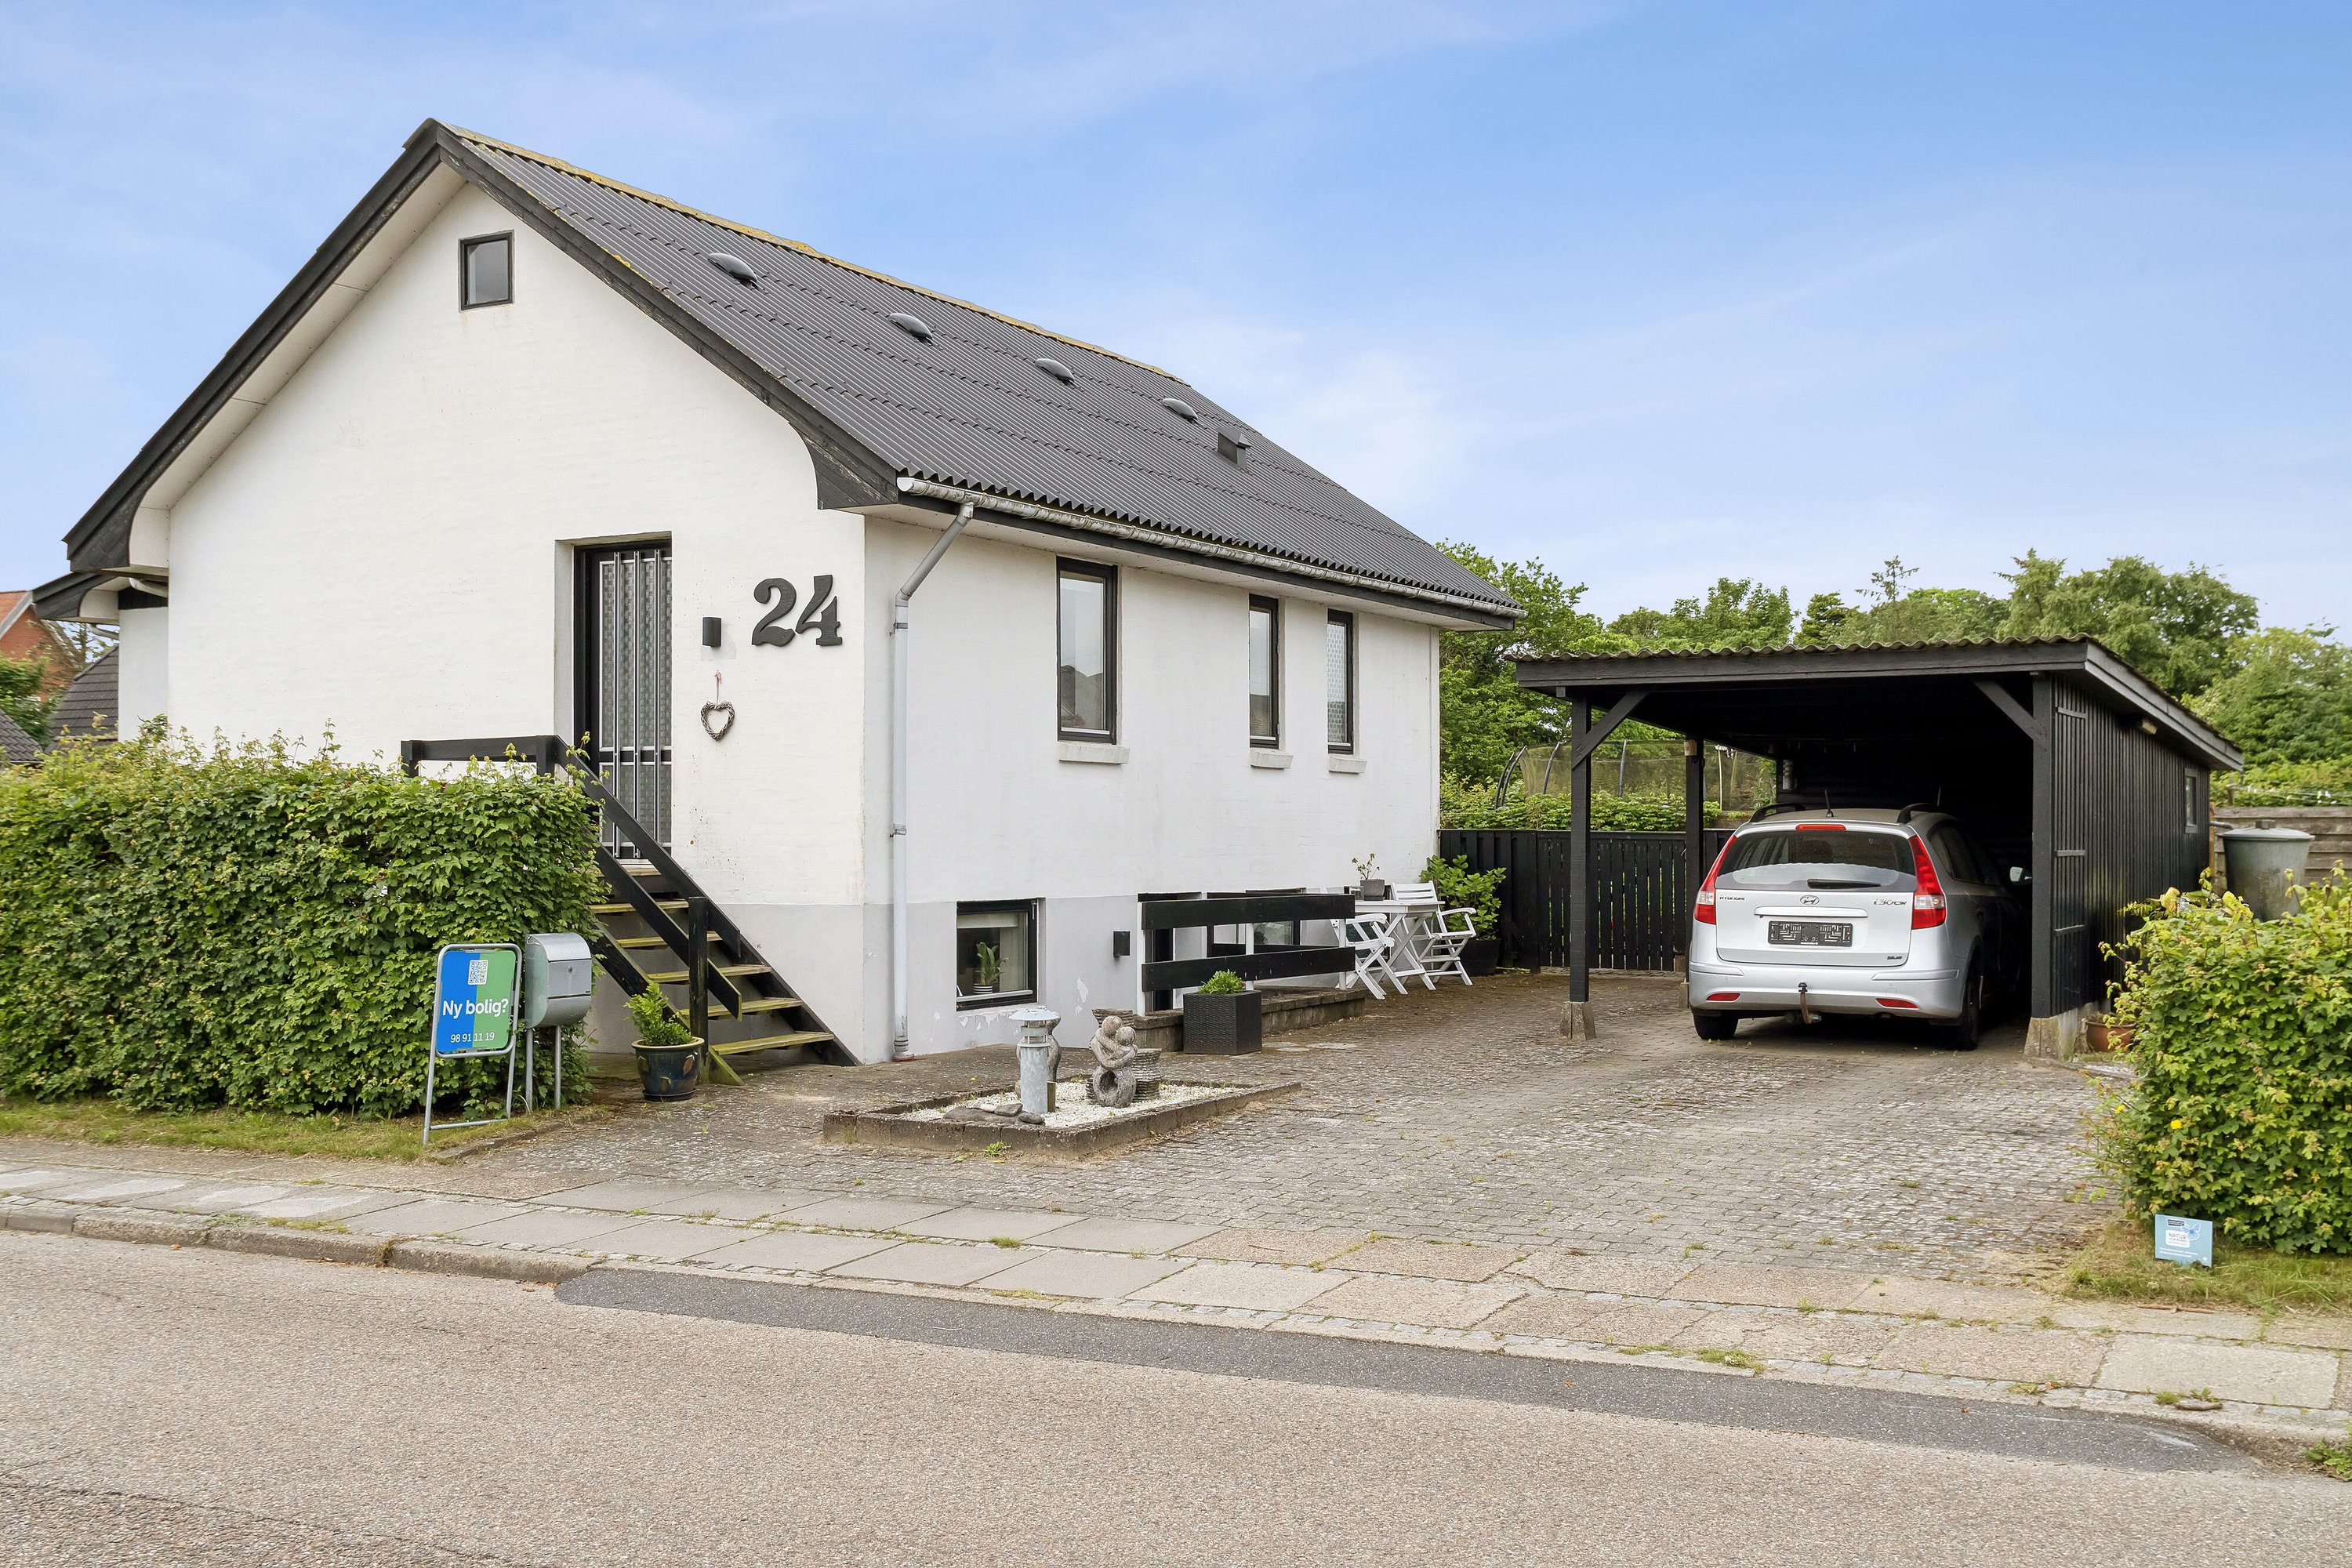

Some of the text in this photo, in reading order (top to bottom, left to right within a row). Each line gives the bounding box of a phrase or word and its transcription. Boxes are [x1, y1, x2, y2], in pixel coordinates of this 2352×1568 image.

[751, 575, 843, 647] 24
[442, 998, 509, 1019] Ny bolig?
[450, 1032, 495, 1043] 98 91 11 19
